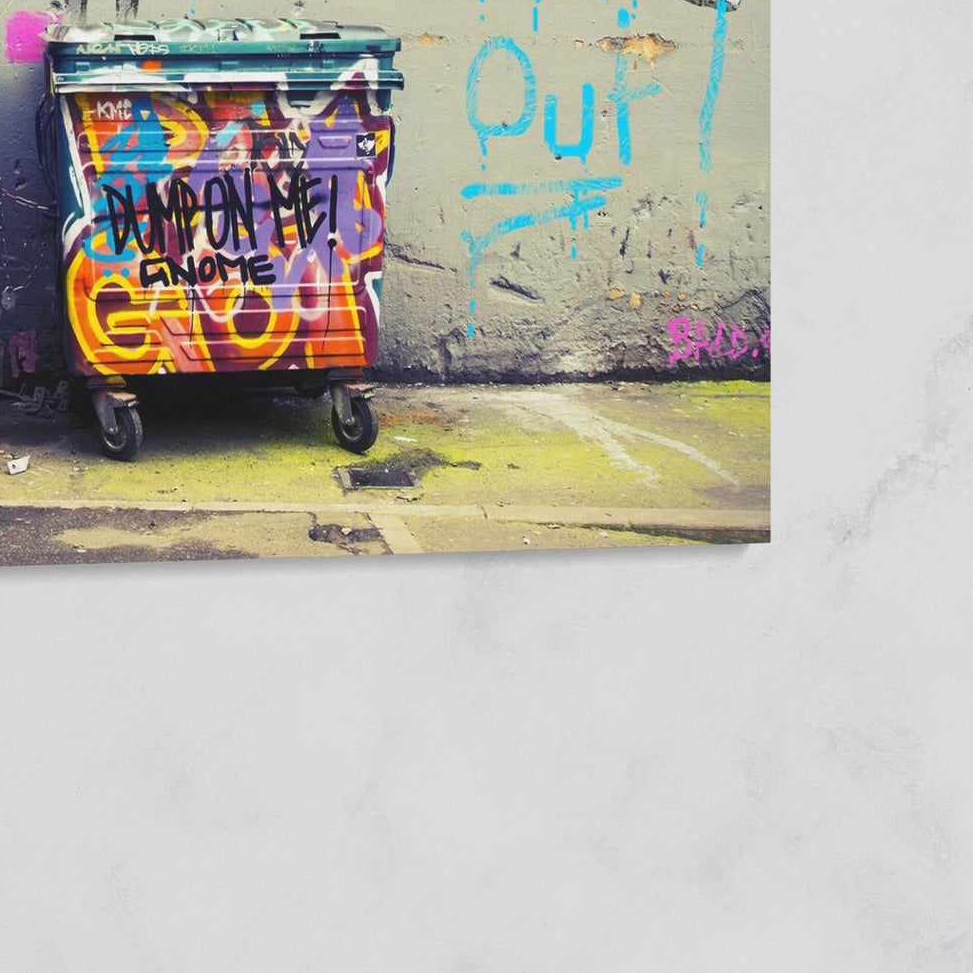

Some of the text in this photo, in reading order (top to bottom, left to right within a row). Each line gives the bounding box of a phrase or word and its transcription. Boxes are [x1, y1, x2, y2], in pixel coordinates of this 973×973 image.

[102, 168, 338, 255] DUMP ON ME!
[139, 253, 277, 288] GNOME
